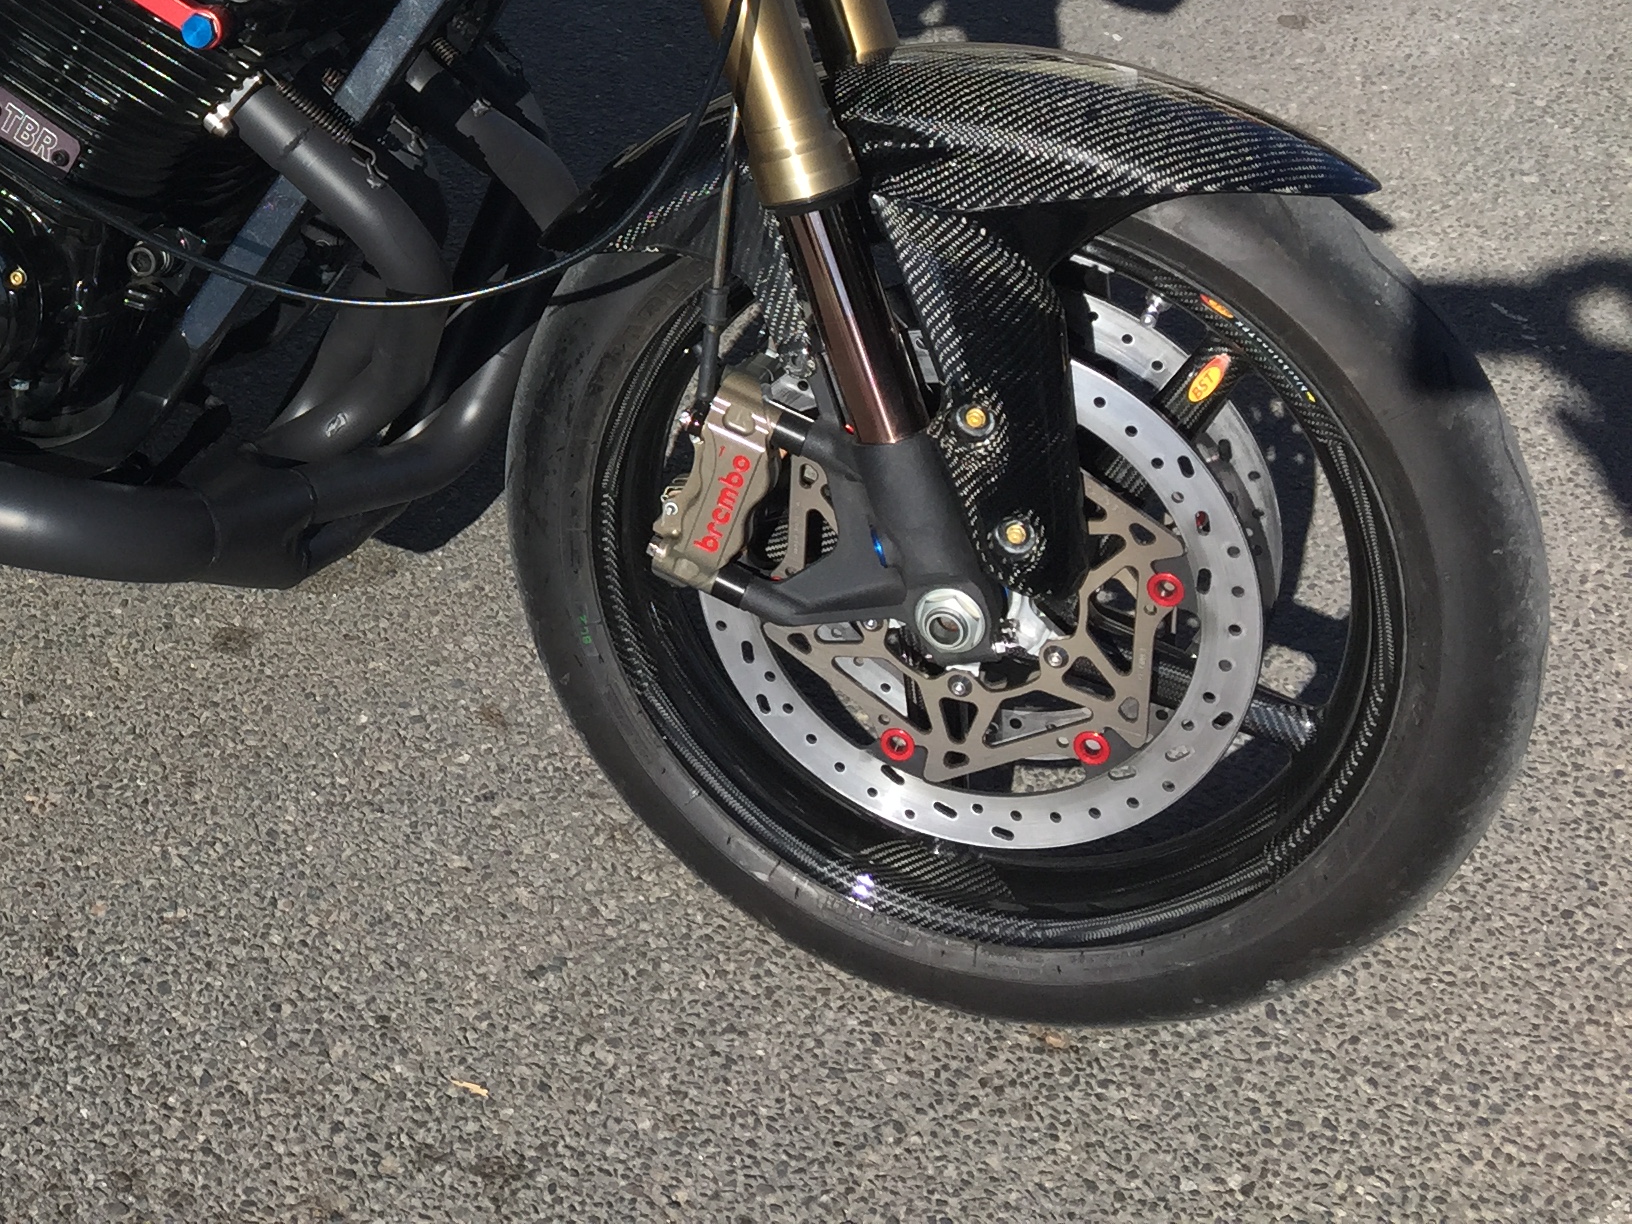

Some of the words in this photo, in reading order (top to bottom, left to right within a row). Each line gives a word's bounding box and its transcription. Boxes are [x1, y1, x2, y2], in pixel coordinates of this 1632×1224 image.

[0, 101, 59, 163] TBR
[1191, 369, 1215, 401] BST
[693, 454, 751, 553] brembo
